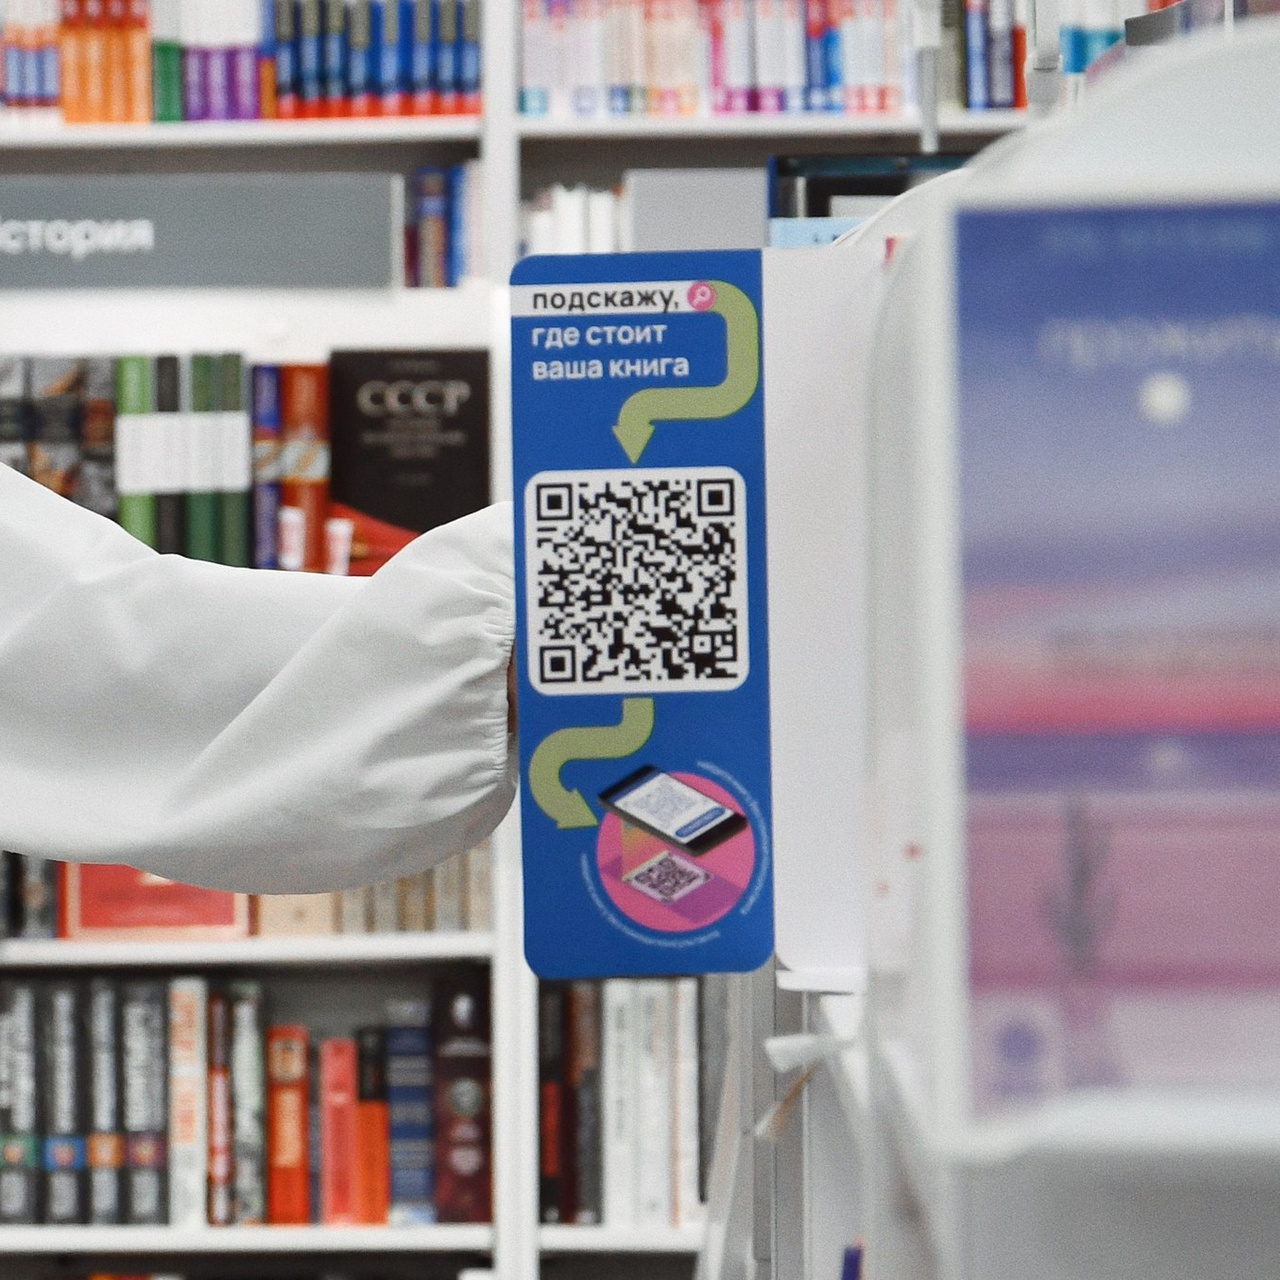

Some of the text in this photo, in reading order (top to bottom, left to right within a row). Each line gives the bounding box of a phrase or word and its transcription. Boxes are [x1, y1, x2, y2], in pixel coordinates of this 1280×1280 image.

[532, 290, 680, 313] подскажу,
[531, 324, 667, 349] где стоит
[532, 357, 689, 380] ваша книга
